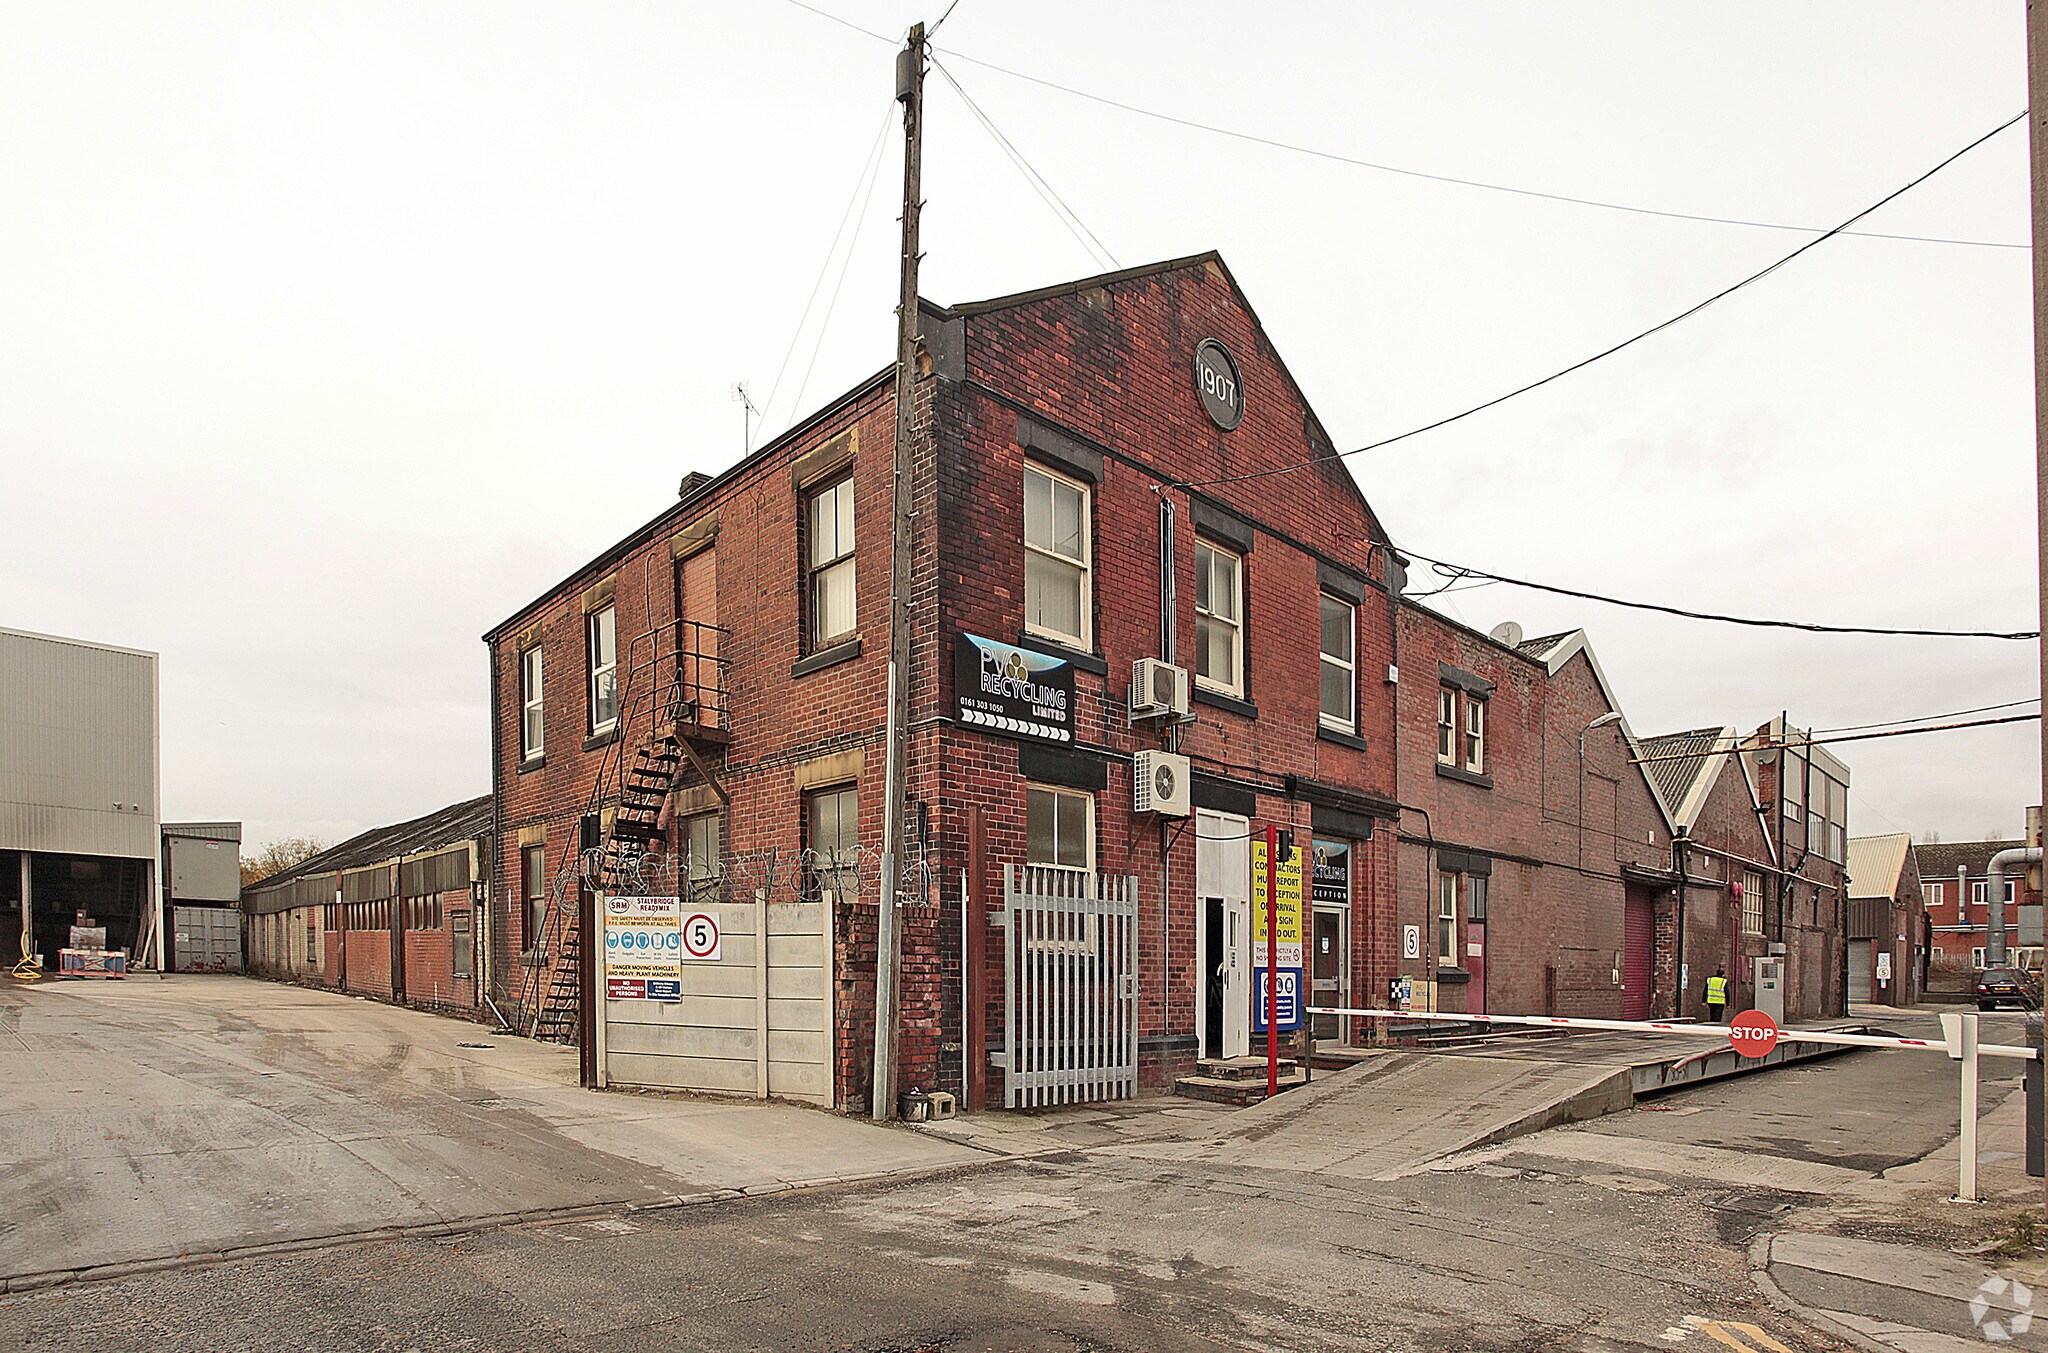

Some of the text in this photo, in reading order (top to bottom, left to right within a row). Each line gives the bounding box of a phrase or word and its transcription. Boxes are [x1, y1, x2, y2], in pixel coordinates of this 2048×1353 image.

[1200, 363, 1235, 407] 1907
[980, 671, 1066, 710] RECYCLING
[960, 696, 1004, 713] 0161 303 1050
[1032, 704, 1066, 722] LIMITED
[1256, 888, 1265, 896] TO
[1314, 890, 1346, 898] CEPTION
[1276, 903, 1296, 912] RRIVAL
[1279, 916, 1293, 924] SIGN
[694, 925, 707, 946] 5
[1409, 934, 1415, 949] 5
[1732, 1026, 1774, 1040] STOP
